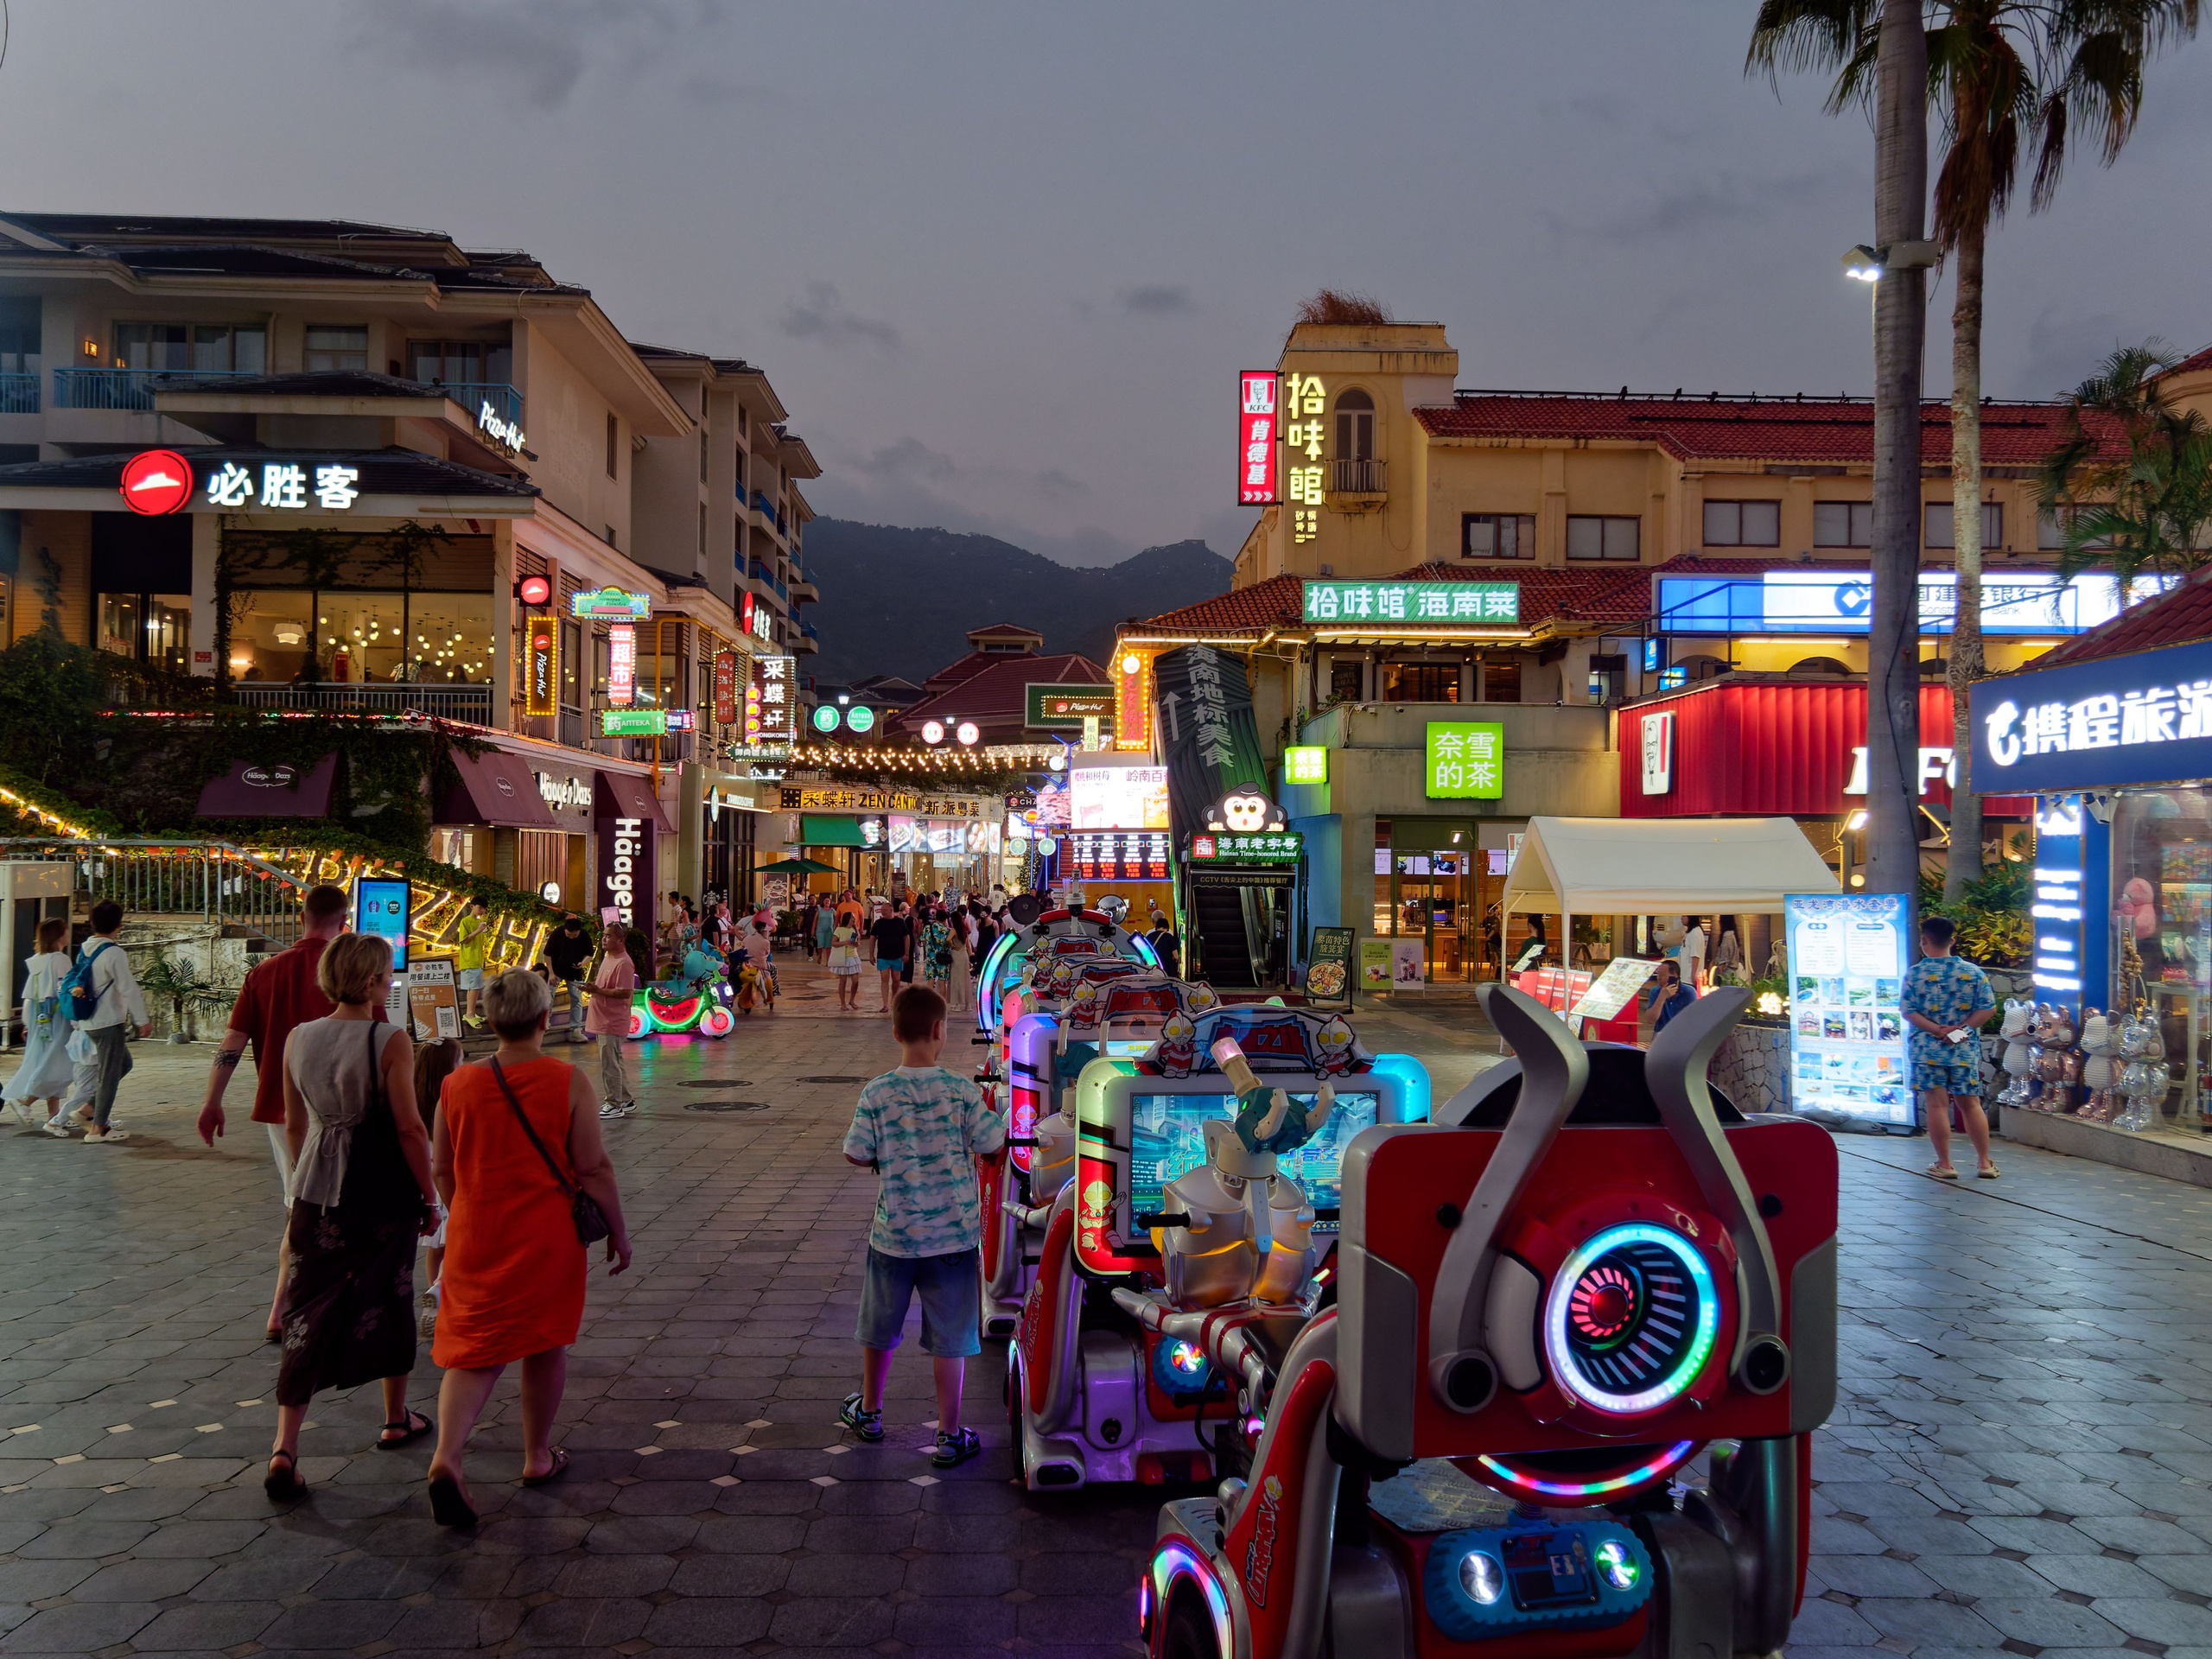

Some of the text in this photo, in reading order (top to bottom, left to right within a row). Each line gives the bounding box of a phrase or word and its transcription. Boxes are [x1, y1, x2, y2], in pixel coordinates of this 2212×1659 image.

[1249, 404, 1269, 412] KFC
[479, 400, 526, 454] Pizza Hut
[1286, 372, 1326, 505] 拾味館
[1246, 420, 1270, 485] 肯德基
[207, 461, 360, 510] 必胜客
[1417, 591, 1516, 617] 海南菜
[1992, 606, 2021, 615] Bank
[537, 652, 548, 699] Pizza Hut
[612, 643, 632, 685] 超市
[762, 659, 785, 729] 采蝶轩
[1070, 702, 1105, 711] Pizza Hut
[1185, 643, 1235, 768] 海南地标美食
[606, 715, 621, 731] 药
[819, 709, 834, 722] 药
[1294, 750, 1323, 764] 奈雪
[1434, 731, 1496, 760] 奈雪
[1294, 764, 1324, 778] 的茶
[1435, 761, 1496, 789] 的茶
[573, 778, 592, 805] Dazs
[804, 791, 855, 808] 采蝶轩
[859, 792, 887, 808] ZEN
[925, 800, 980, 817] 新派粤菜
[1217, 836, 1299, 849] 海南老字号
[607, 817, 641, 928] Häagen
[1792, 899, 1897, 911] 亚龙湾潜水套票
[410, 972, 451, 982] 用餐请上二楼
